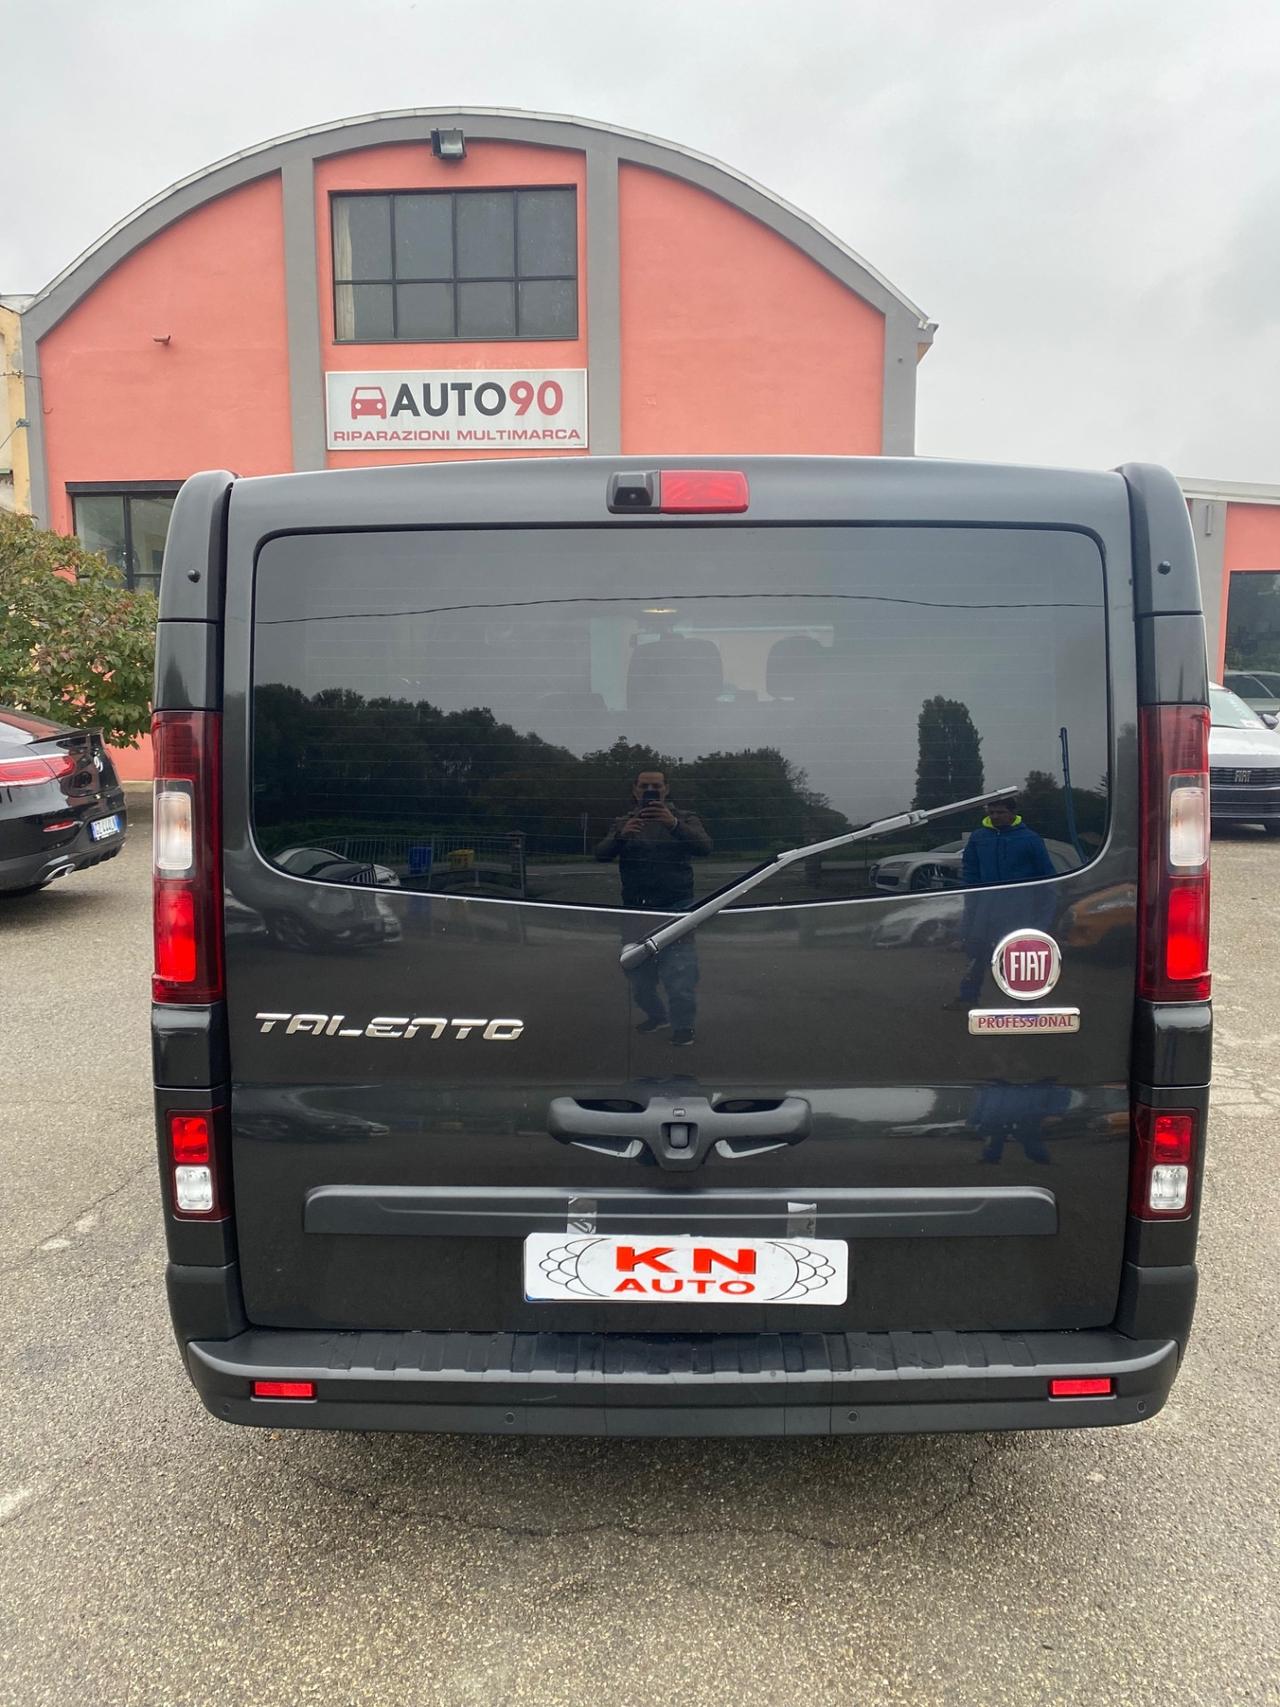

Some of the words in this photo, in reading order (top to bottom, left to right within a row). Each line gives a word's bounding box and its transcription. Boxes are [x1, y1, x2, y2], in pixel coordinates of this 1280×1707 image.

[390, 380, 564, 417] AUTO90
[333, 430, 450, 442] RIPARAZIONI
[456, 429, 580, 441] MULTIMARCA
[1010, 951, 1048, 981] FIAT
[255, 1012, 525, 1041] TALENTO
[978, 1014, 1074, 1028] PROFESSIONAL
[614, 1278, 756, 1295] AUTO
